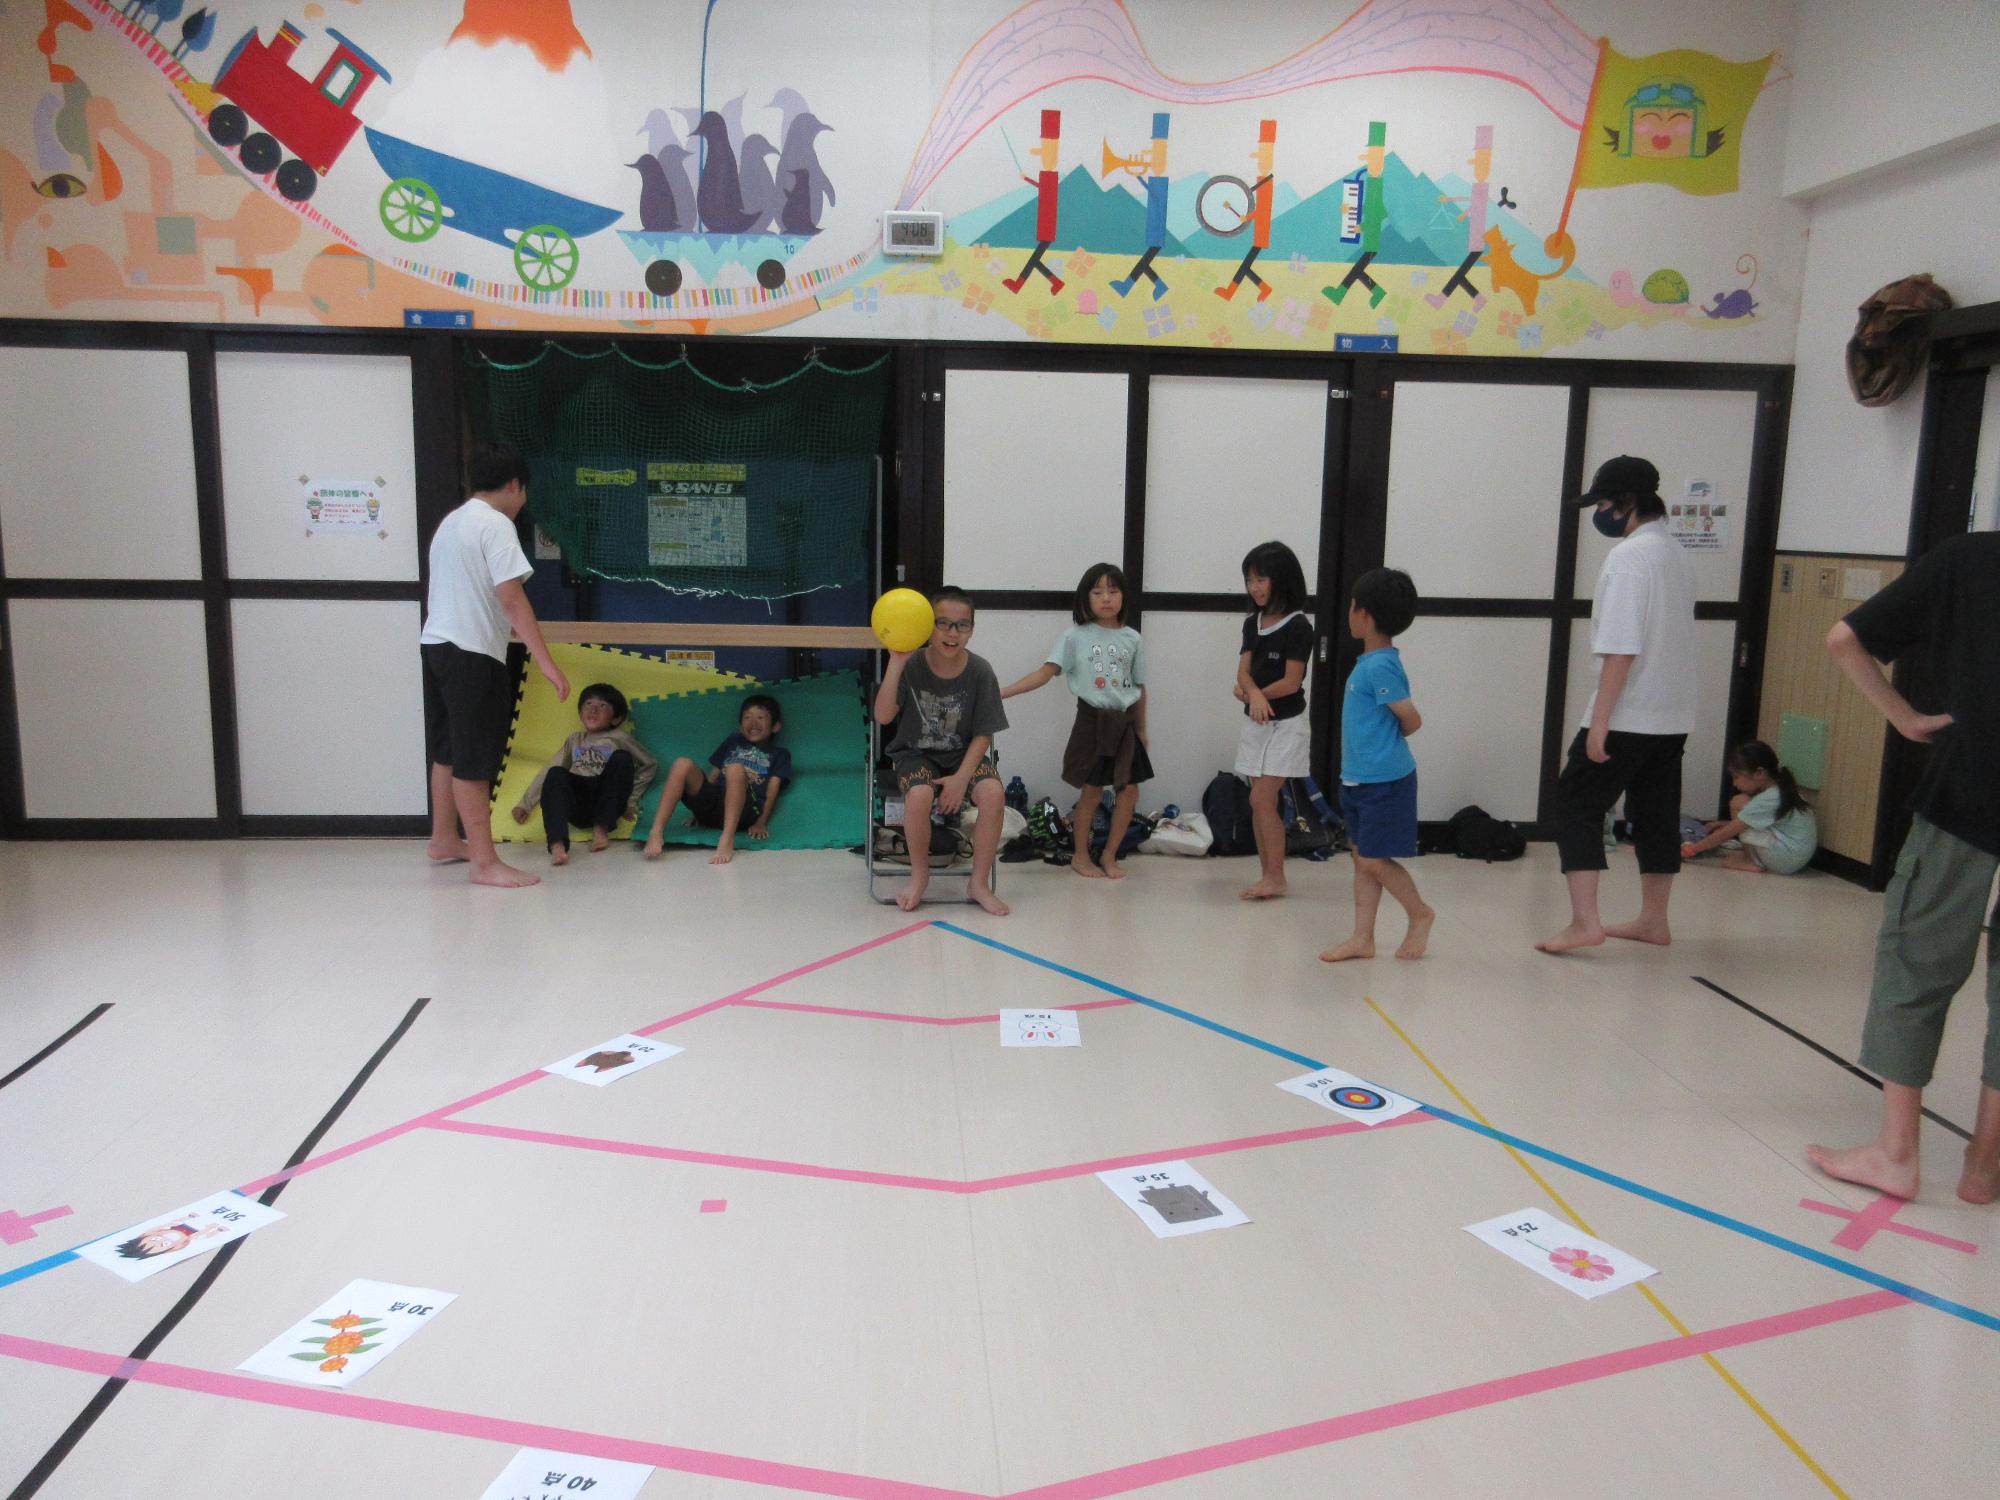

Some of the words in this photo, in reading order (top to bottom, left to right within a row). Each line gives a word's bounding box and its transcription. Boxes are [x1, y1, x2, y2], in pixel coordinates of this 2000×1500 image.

[1341, 338, 1391, 350] 物入
[388, 1301, 434, 1316] 30点
[541, 1471, 598, 1491] 40点
